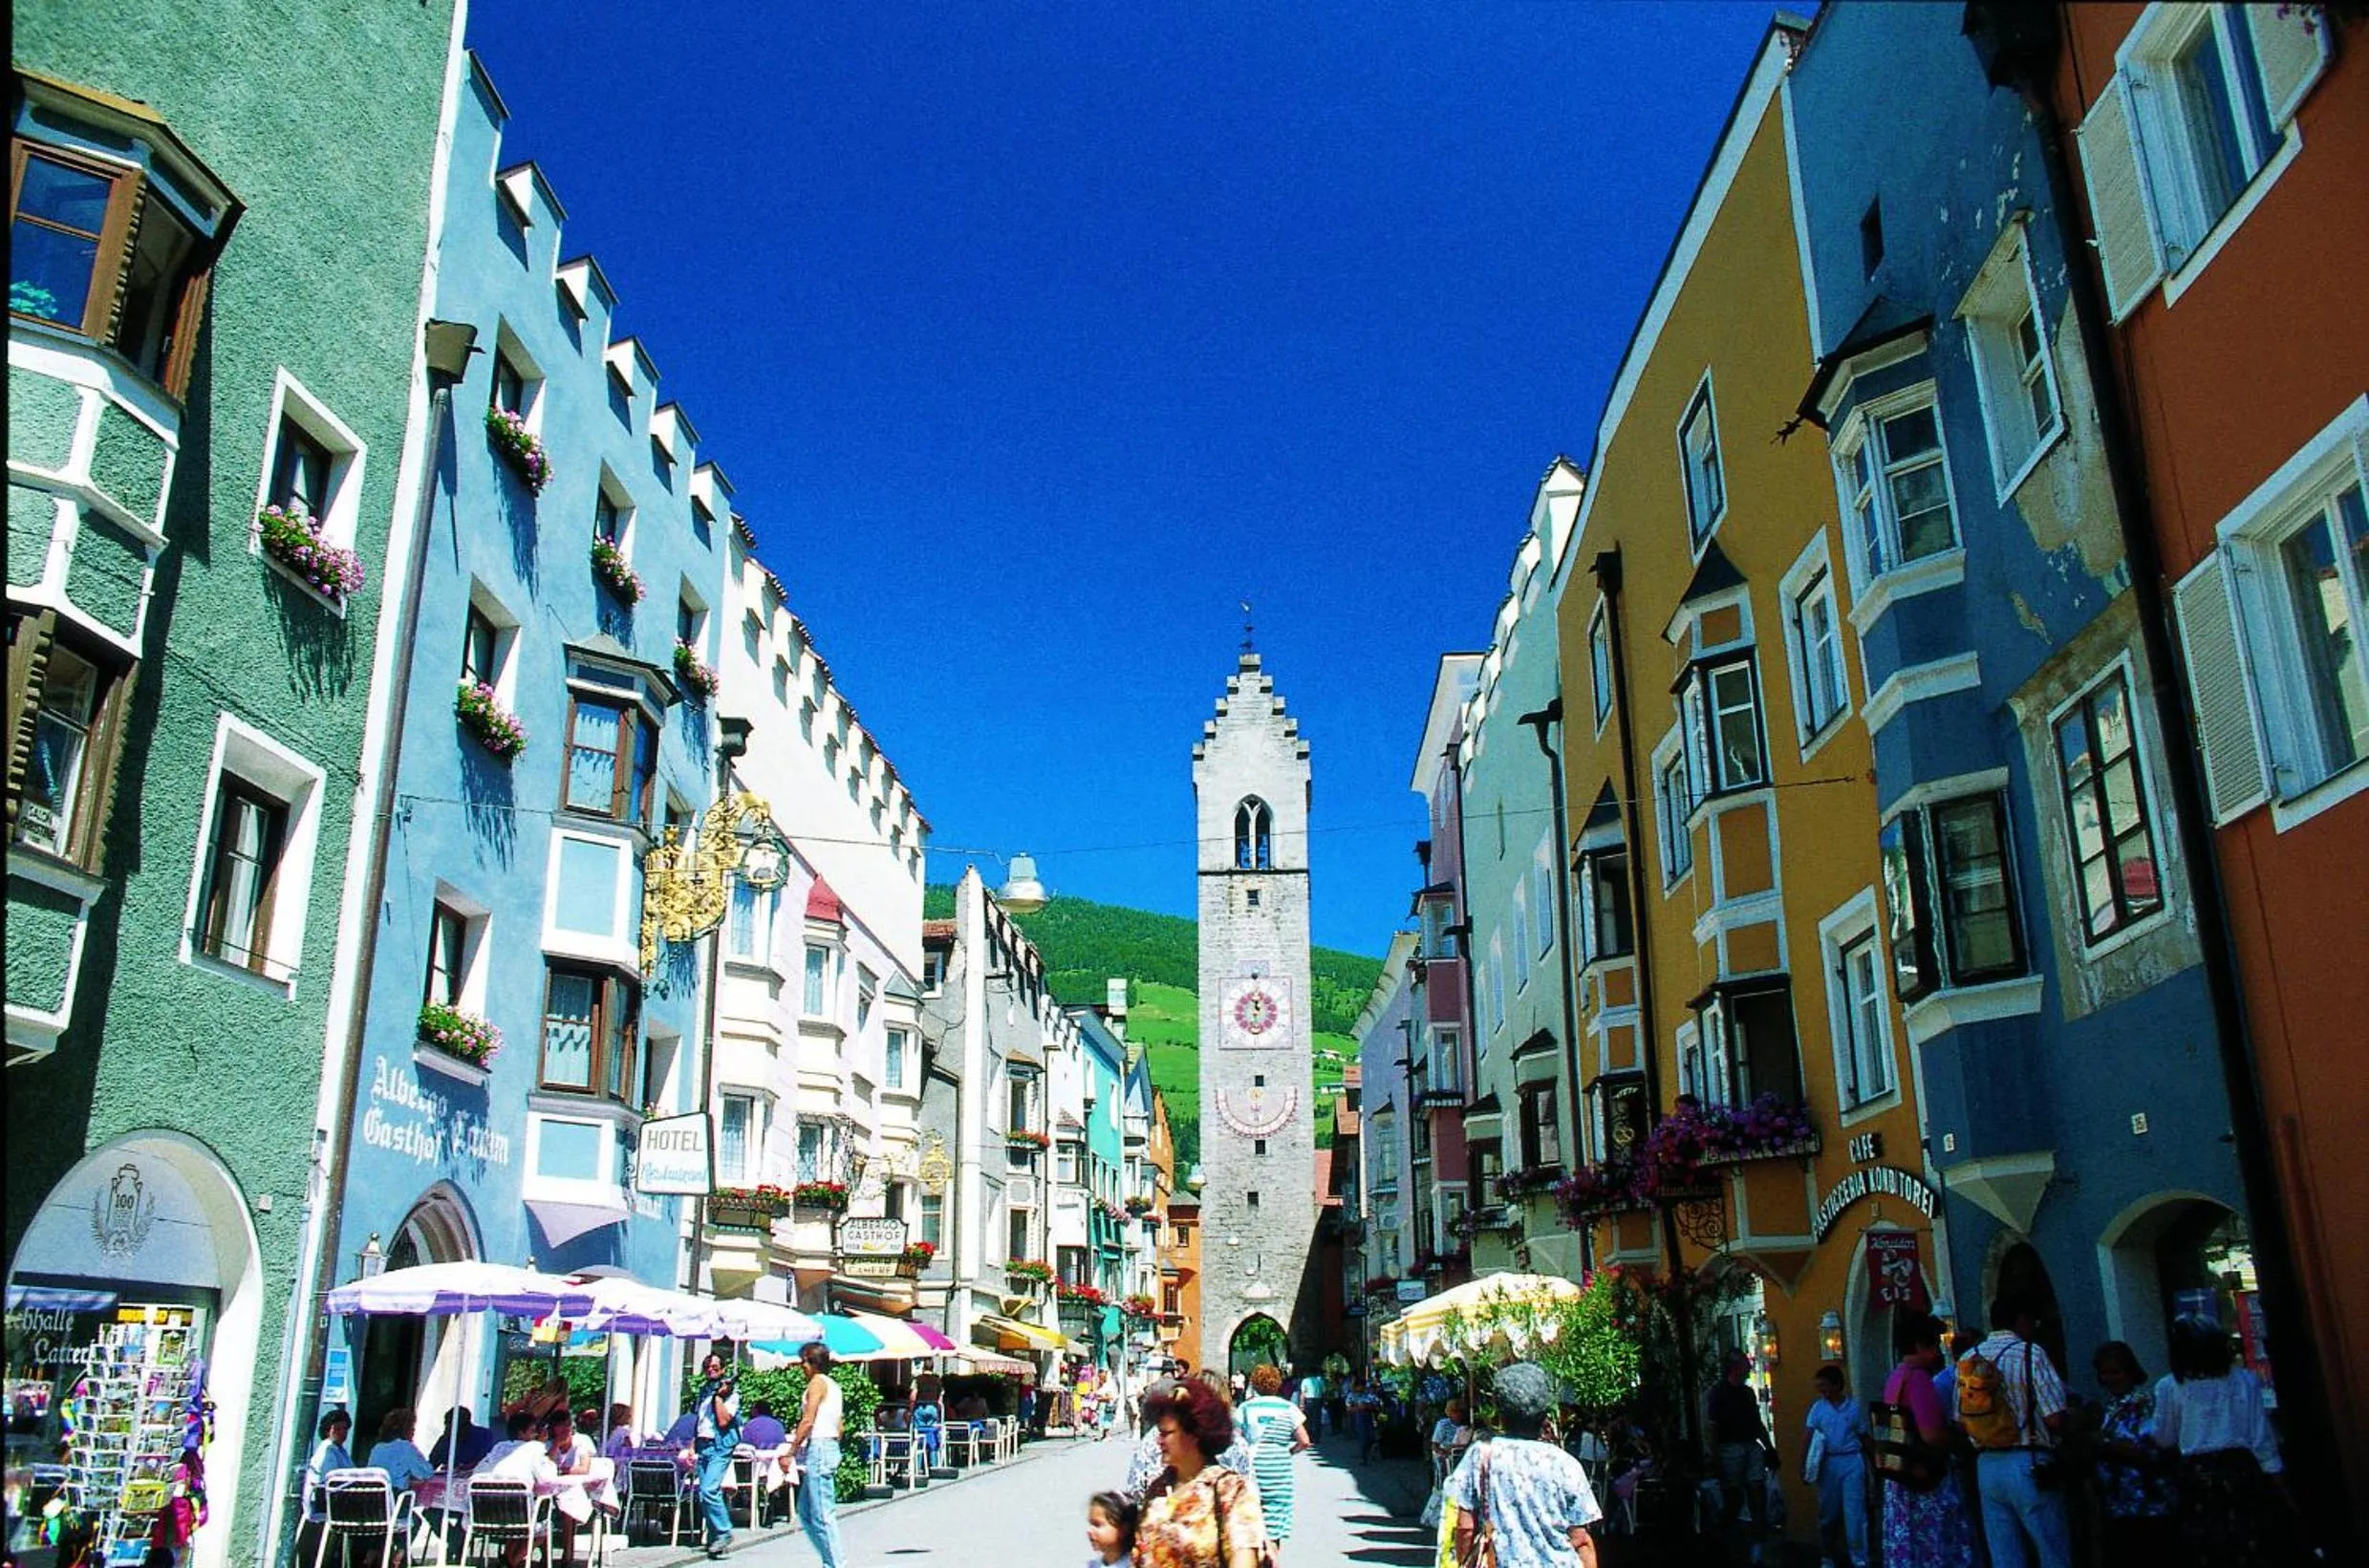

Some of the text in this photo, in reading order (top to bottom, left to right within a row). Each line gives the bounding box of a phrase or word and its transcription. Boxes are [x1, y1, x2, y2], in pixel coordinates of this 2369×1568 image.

[370, 1055, 447, 1124] Albergo
[362, 1106, 447, 1169] Gasthof
[646, 1129, 704, 1152] HOTEL
[115, 1193, 135, 1210] 100
[1867, 1166, 1934, 1219] KONDITOREI
[849, 1218, 898, 1230] ALBERGO
[848, 1231, 900, 1240] GASTHOF
[1880, 1286, 1912, 1302] EIS
